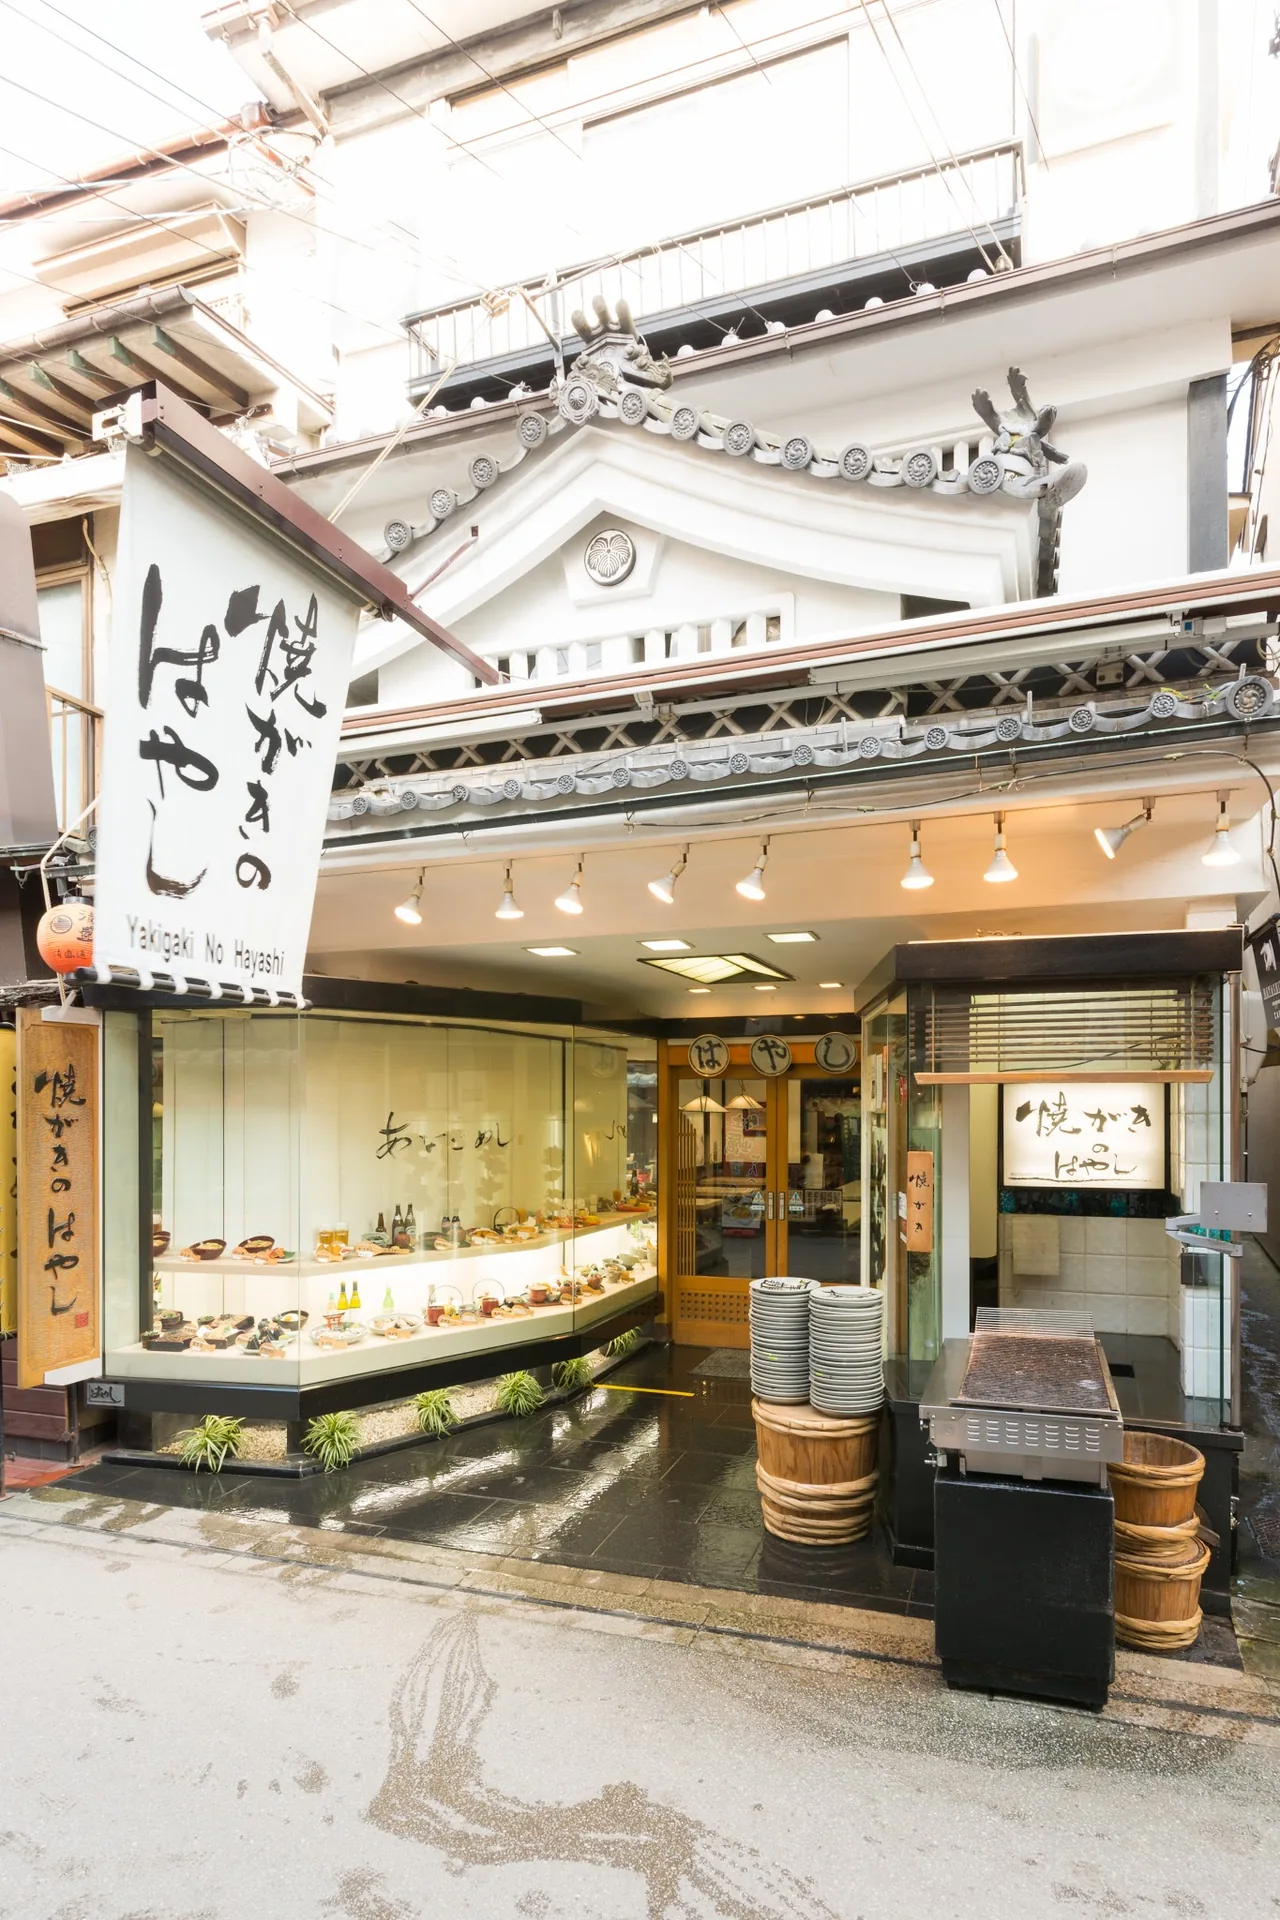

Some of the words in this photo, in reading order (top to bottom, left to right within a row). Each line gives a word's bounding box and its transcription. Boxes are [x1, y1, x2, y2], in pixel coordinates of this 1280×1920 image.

[137, 564, 220, 898] はやし
[225, 585, 326, 890] 焼がきの
[126, 914, 194, 963] Yakigaki
[205, 933, 223, 964] No
[234, 939, 284, 978] Hayashi
[695, 1037, 850, 1071] はやし
[1015, 1091, 1151, 1137] 焼がき
[1054, 1151, 1137, 1178] はやし
[1092, 1143, 1109, 1153] の
[34, 1063, 86, 1316] 焼がきのはやし
[909, 1171, 930, 1232] 焼がき
